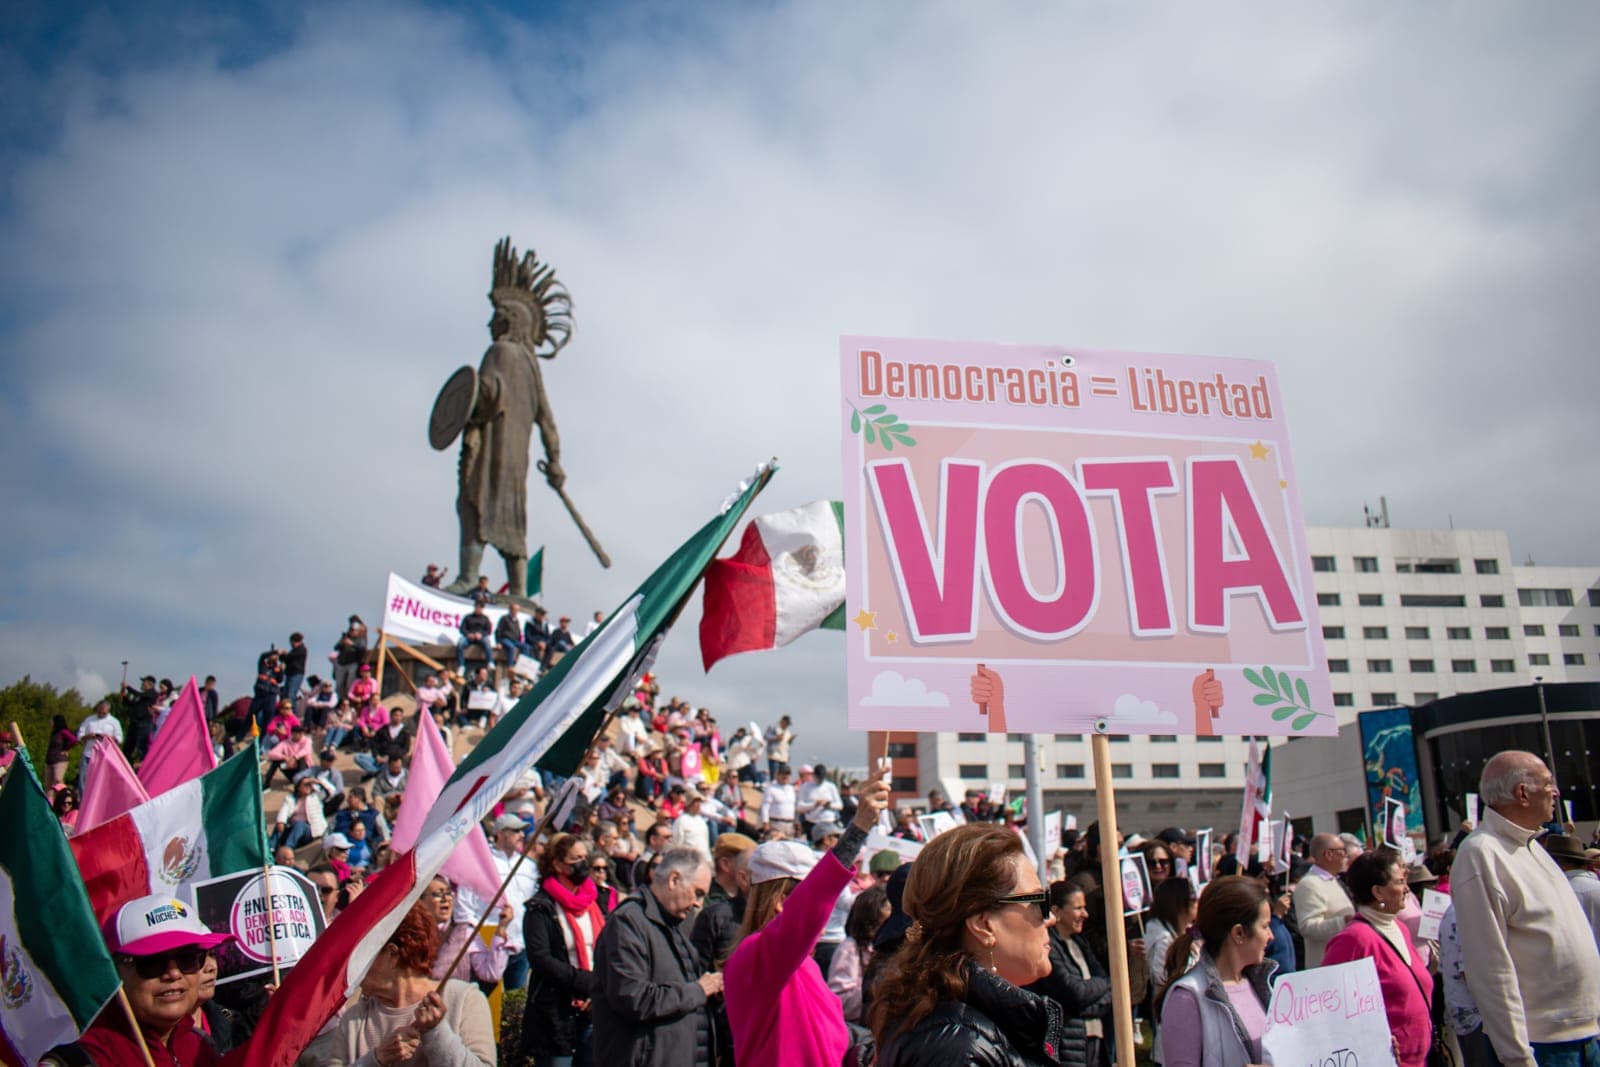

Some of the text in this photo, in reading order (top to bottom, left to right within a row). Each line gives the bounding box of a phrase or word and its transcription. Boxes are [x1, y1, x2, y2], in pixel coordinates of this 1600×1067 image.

[859, 350, 1080, 407] Democracia
[1128, 366, 1273, 420] Libertad
[870, 457, 1305, 639] VOTA
[391, 594, 460, 629] #Nuest
[245, 910, 308, 930] DEMCACIA
